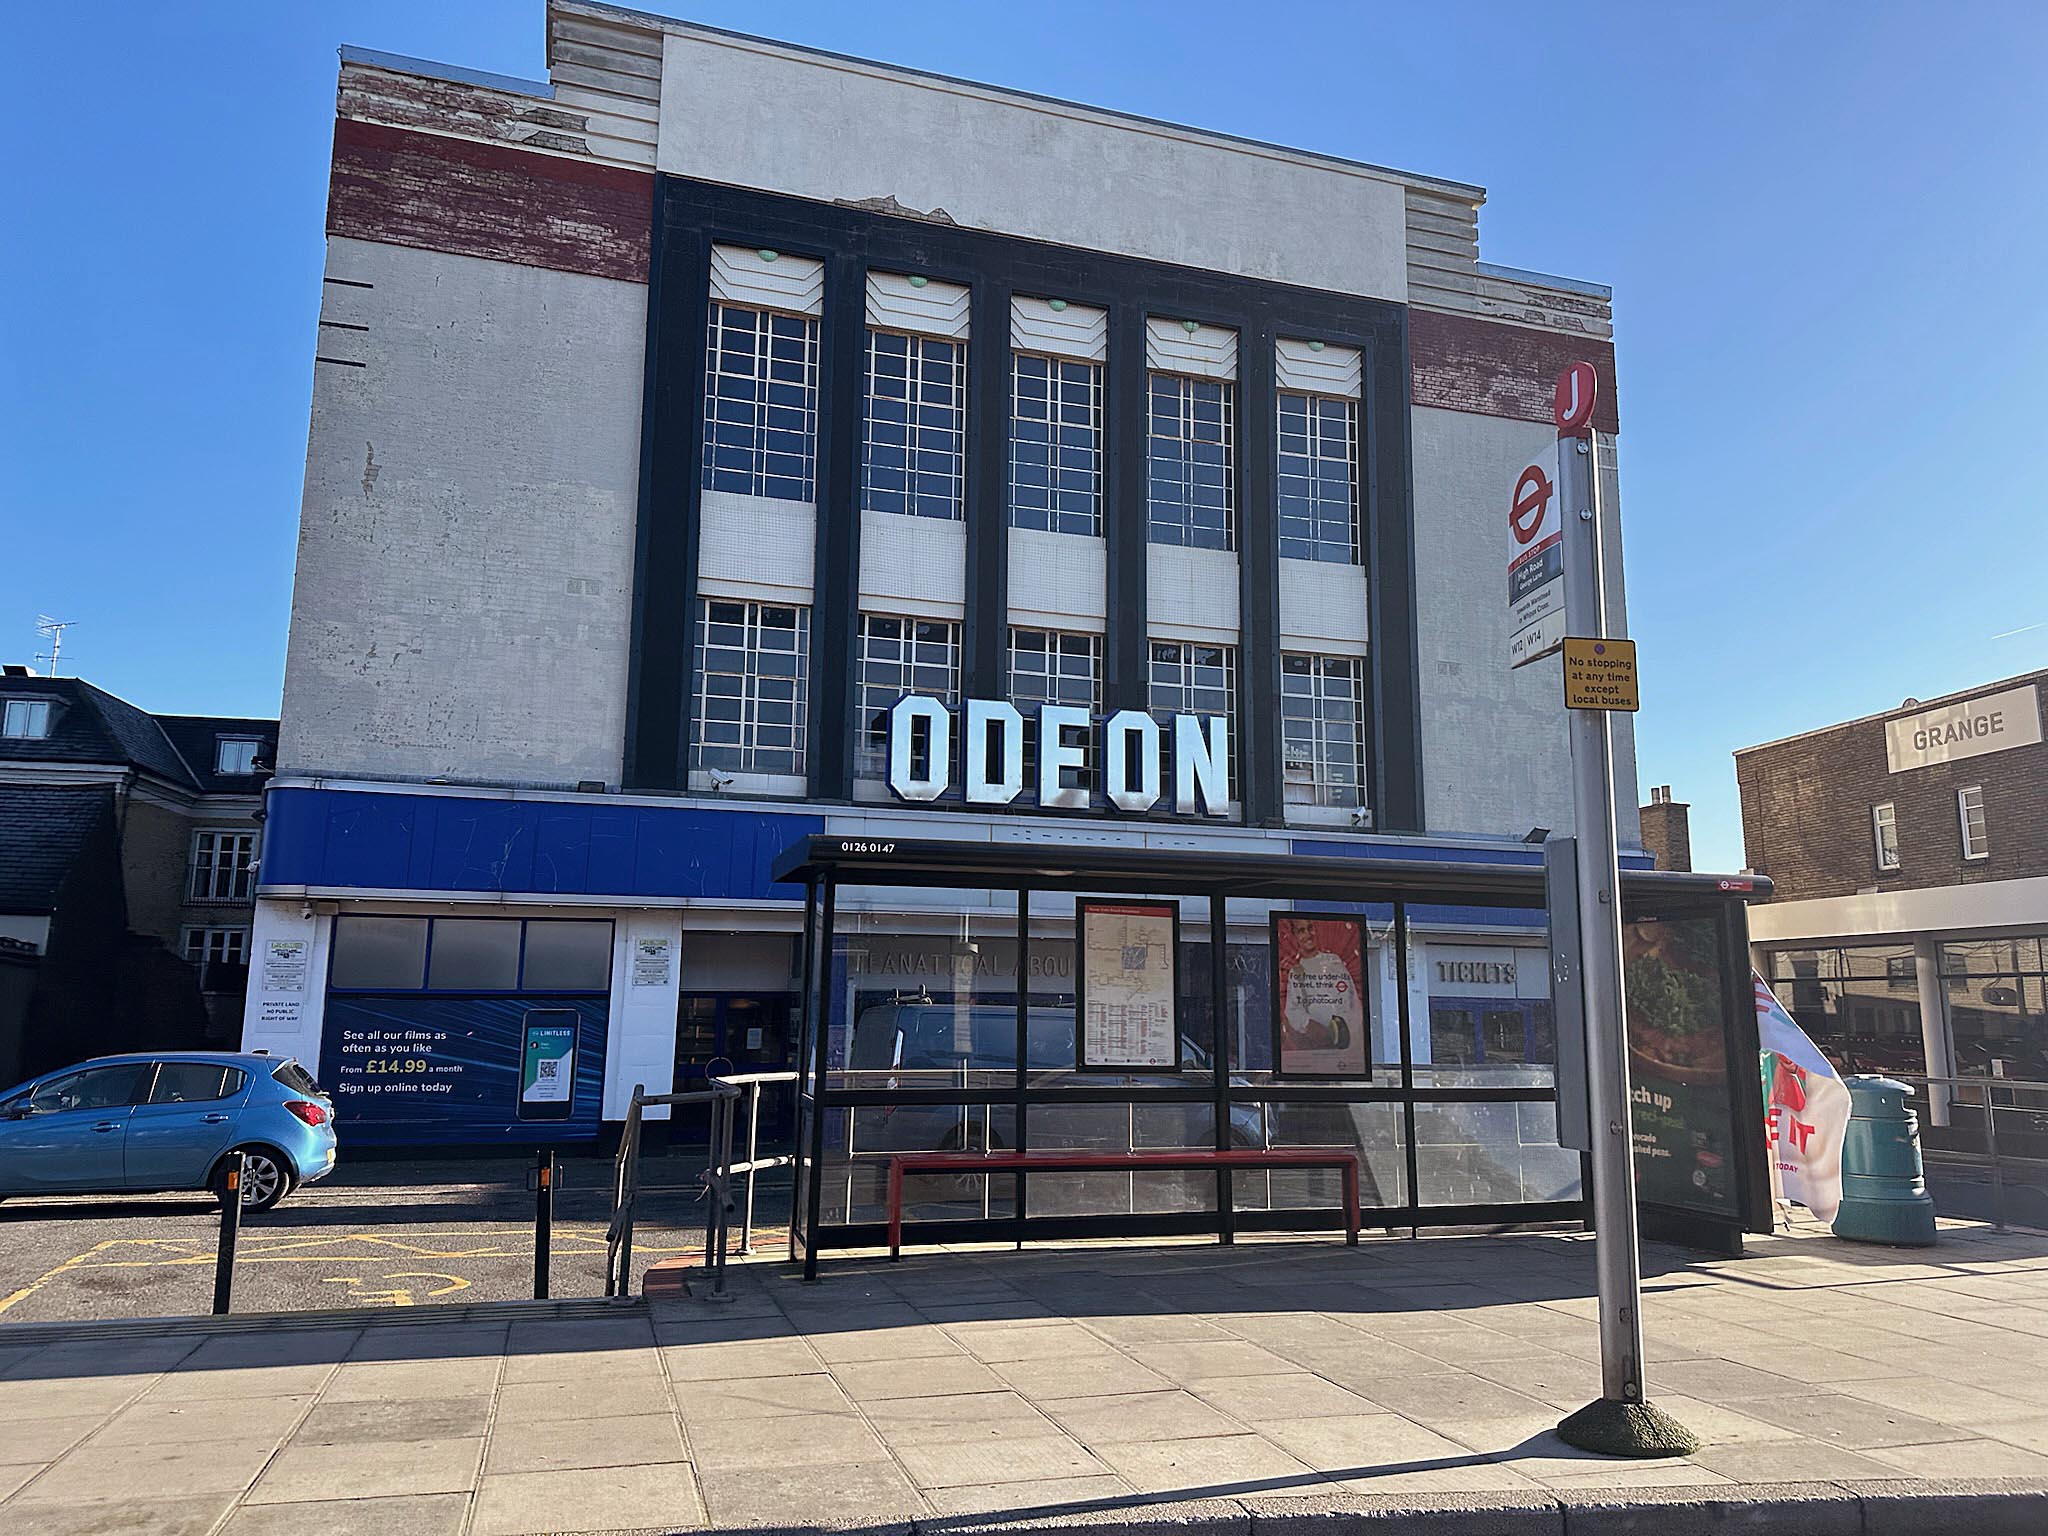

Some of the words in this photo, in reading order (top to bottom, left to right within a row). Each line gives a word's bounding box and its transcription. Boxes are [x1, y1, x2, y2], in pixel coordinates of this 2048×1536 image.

[1562, 369, 1579, 421] J
[1517, 567, 1529, 581] High
[1529, 558, 1543, 572] Road
[1532, 572, 1543, 581] Lane
[1511, 640, 1523, 655] W12
[1526, 629, 1541, 646] W14
[1569, 657, 1584, 666] No
[1587, 658, 1632, 670] stopping
[1572, 671, 1583, 680] at
[1586, 673, 1604, 682] any
[1607, 672, 1630, 682] time
[1585, 685, 1619, 694] except
[1573, 694, 1599, 704] local
[1601, 695, 1632, 705] buses
[1913, 711, 2004, 751] GRANGE
[887, 693, 1229, 818] ODEON
[841, 841, 867, 853] 0126
[869, 842, 895, 853] 0147
[1436, 961, 1516, 984] TICKETS
[343, 1030, 364, 1040] See
[367, 1030, 380, 1040] all
[383, 1032, 402, 1040] our
[404, 1030, 431, 1040] films
[434, 1032, 447, 1040] as
[342, 1043, 371, 1053] often
[374, 1045, 387, 1053] as
[389, 1045, 410, 1054] you
[412, 1043, 432, 1053] like
[340, 1065, 362, 1073] From
[365, 1059, 427, 1074] £14.99
[435, 1065, 463, 1073] month
[338, 1083, 364, 1095] Sign
[367, 1084, 382, 1094] up
[384, 1083, 418, 1092] online
[421, 1083, 453, 1093] today
[1631, 1086, 1651, 1105] ch
[1654, 1092, 1672, 1113] up
[1789, 1114, 1815, 1155] IT
[1776, 1162, 1798, 1174] TODAY
